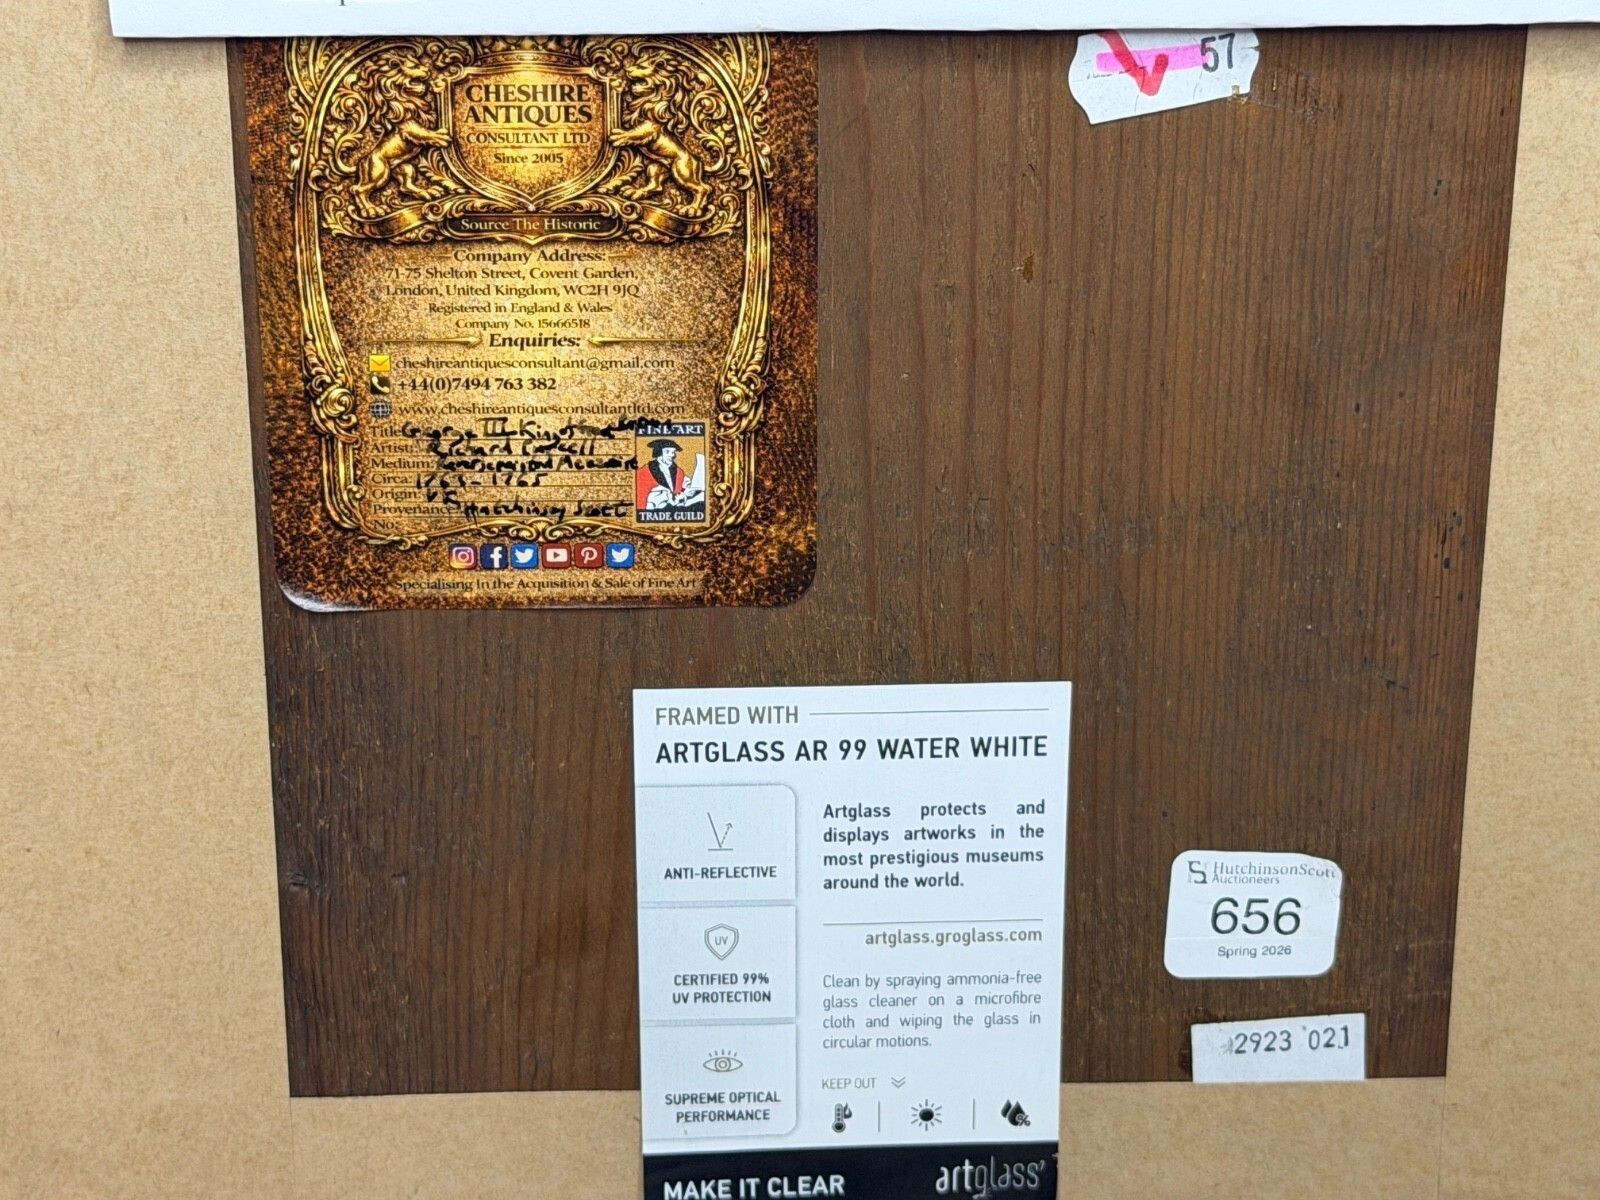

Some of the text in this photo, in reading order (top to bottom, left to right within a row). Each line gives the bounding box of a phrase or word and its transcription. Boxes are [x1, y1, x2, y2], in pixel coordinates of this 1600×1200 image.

[1200, 32, 1236, 73] 57
[465, 84, 592, 103] CHESHIRE
[464, 105, 593, 127] ANTIQUES
[466, 132, 591, 144] CONSULTANT LTD
[494, 153, 564, 164] Since 2005
[461, 218, 601, 231] Source The Historic
[454, 249, 606, 265] Company Address:
[385, 267, 639, 281] 71-75 Shelton Street, Covent Garden,
[385, 284, 640, 300] London, United Kingdom, WC2H 9JQ
[429, 302, 613, 316] Registered in England & Wales
[455, 318, 510, 330] Company
[514, 318, 534, 329] No.
[489, 333, 581, 350] Enquiries:
[395, 356, 675, 371] cheshireantiquesconsultant@gmail.com
[399, 376, 557, 392] +44(0)7494 763 382
[399, 402, 685, 416] www.cheshireantiquesconsultantltd.com
[370, 444, 415, 455] Artist:
[371, 458, 435, 470] Medium:
[639, 511, 704, 522] TRADE GUILD
[396, 577, 474, 592] Specialising
[494, 578, 514, 589] the
[517, 577, 588, 591] Acquisition
[605, 577, 631, 588] Sale
[633, 576, 647, 588] of
[656, 706, 798, 725] FRAMED WITH
[656, 736, 1047, 763] ARTGLASS AR 99 WATER WHITE
[824, 799, 1044, 821] Artglass protects and
[824, 823, 1044, 845] displays artworks in the
[824, 849, 1043, 869] most prestigious museums
[665, 866, 776, 879] ANTI-REFLECTIVE
[824, 872, 963, 889] around the world.
[1211, 874, 1281, 884] Auctioneers
[1211, 897, 1302, 935] 656
[715, 936, 728, 945] UV
[866, 928, 1041, 948] artglass.groglass.com
[1217, 945, 1292, 959] Spring 2026
[674, 973, 769, 986] CERTIFIED 99%
[824, 971, 1041, 990] Clean by spraying ammonia-free
[673, 991, 771, 1003] UV PROTECTION
[823, 991, 1041, 1011] glass cleaner on a microfibre
[823, 1012, 1040, 1029] cloth and wiping the glass in
[823, 1036, 931, 1048] circular motions.
[1234, 1030, 1292, 1054] 2923
[822, 1078, 876, 1089] KEEP OUT
[665, 1092, 780, 1105] SUPREME OPTICAL
[677, 1109, 769, 1122] PERFORMANCE
[935, 1155, 1040, 1200] artglass
[662, 1174, 846, 1200] MAKE IT CLEAR
